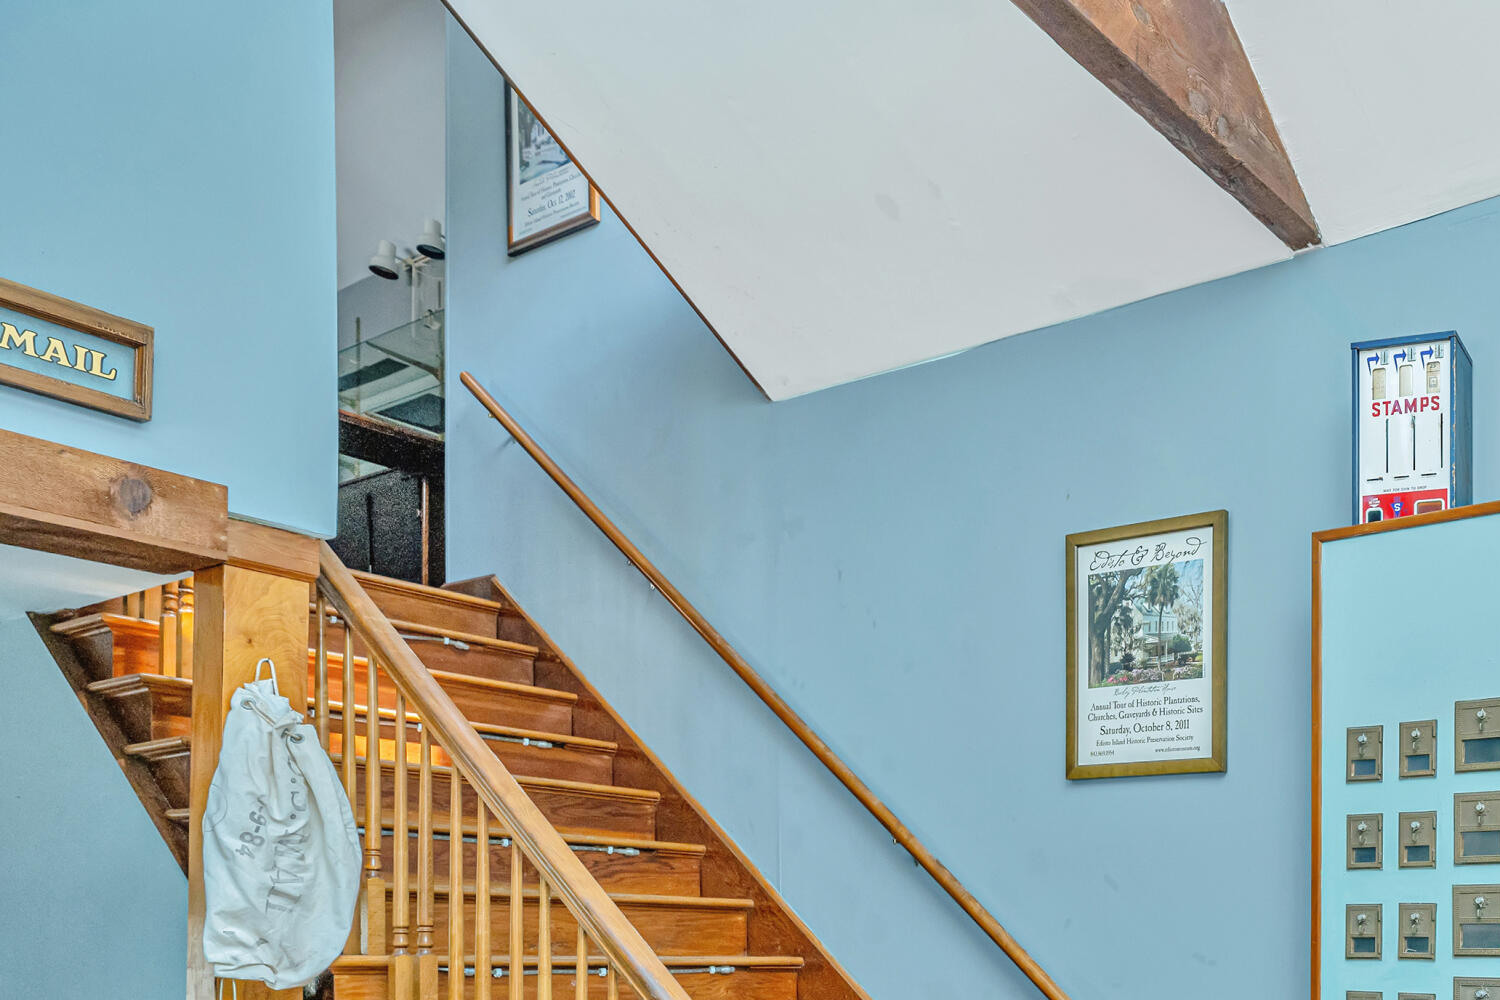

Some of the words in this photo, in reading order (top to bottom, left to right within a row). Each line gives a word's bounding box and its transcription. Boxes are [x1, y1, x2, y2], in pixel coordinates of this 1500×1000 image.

[0, 322, 117, 380] MAIL
[1372, 396, 1440, 418] STAMPS
[1394, 502, 1400, 512] S
[1090, 549, 1127, 571] Edisto
[1151, 536, 1207, 563] Beyond
[1087, 712, 1118, 722] Churches,
[1118, 708, 1151, 720] Graveyards
[1152, 708, 1158, 716] &
[1159, 706, 1186, 716] Historic
[1186, 704, 1204, 714] Sites
[1090, 702, 1112, 712] Annual
[1113, 700, 1127, 710] Tour
[1128, 699, 1135, 708] of
[1136, 698, 1162, 708] Historic
[1164, 696, 1200, 706] Plantations,
[1100, 725, 1132, 737] Saturday,
[1133, 721, 1164, 734] October
[1165, 720, 1173, 732] 8,
[1174, 719, 1190, 730] 2011
[1126, 737, 1146, 745] Historic
[1175, 734, 1194, 742] Society
